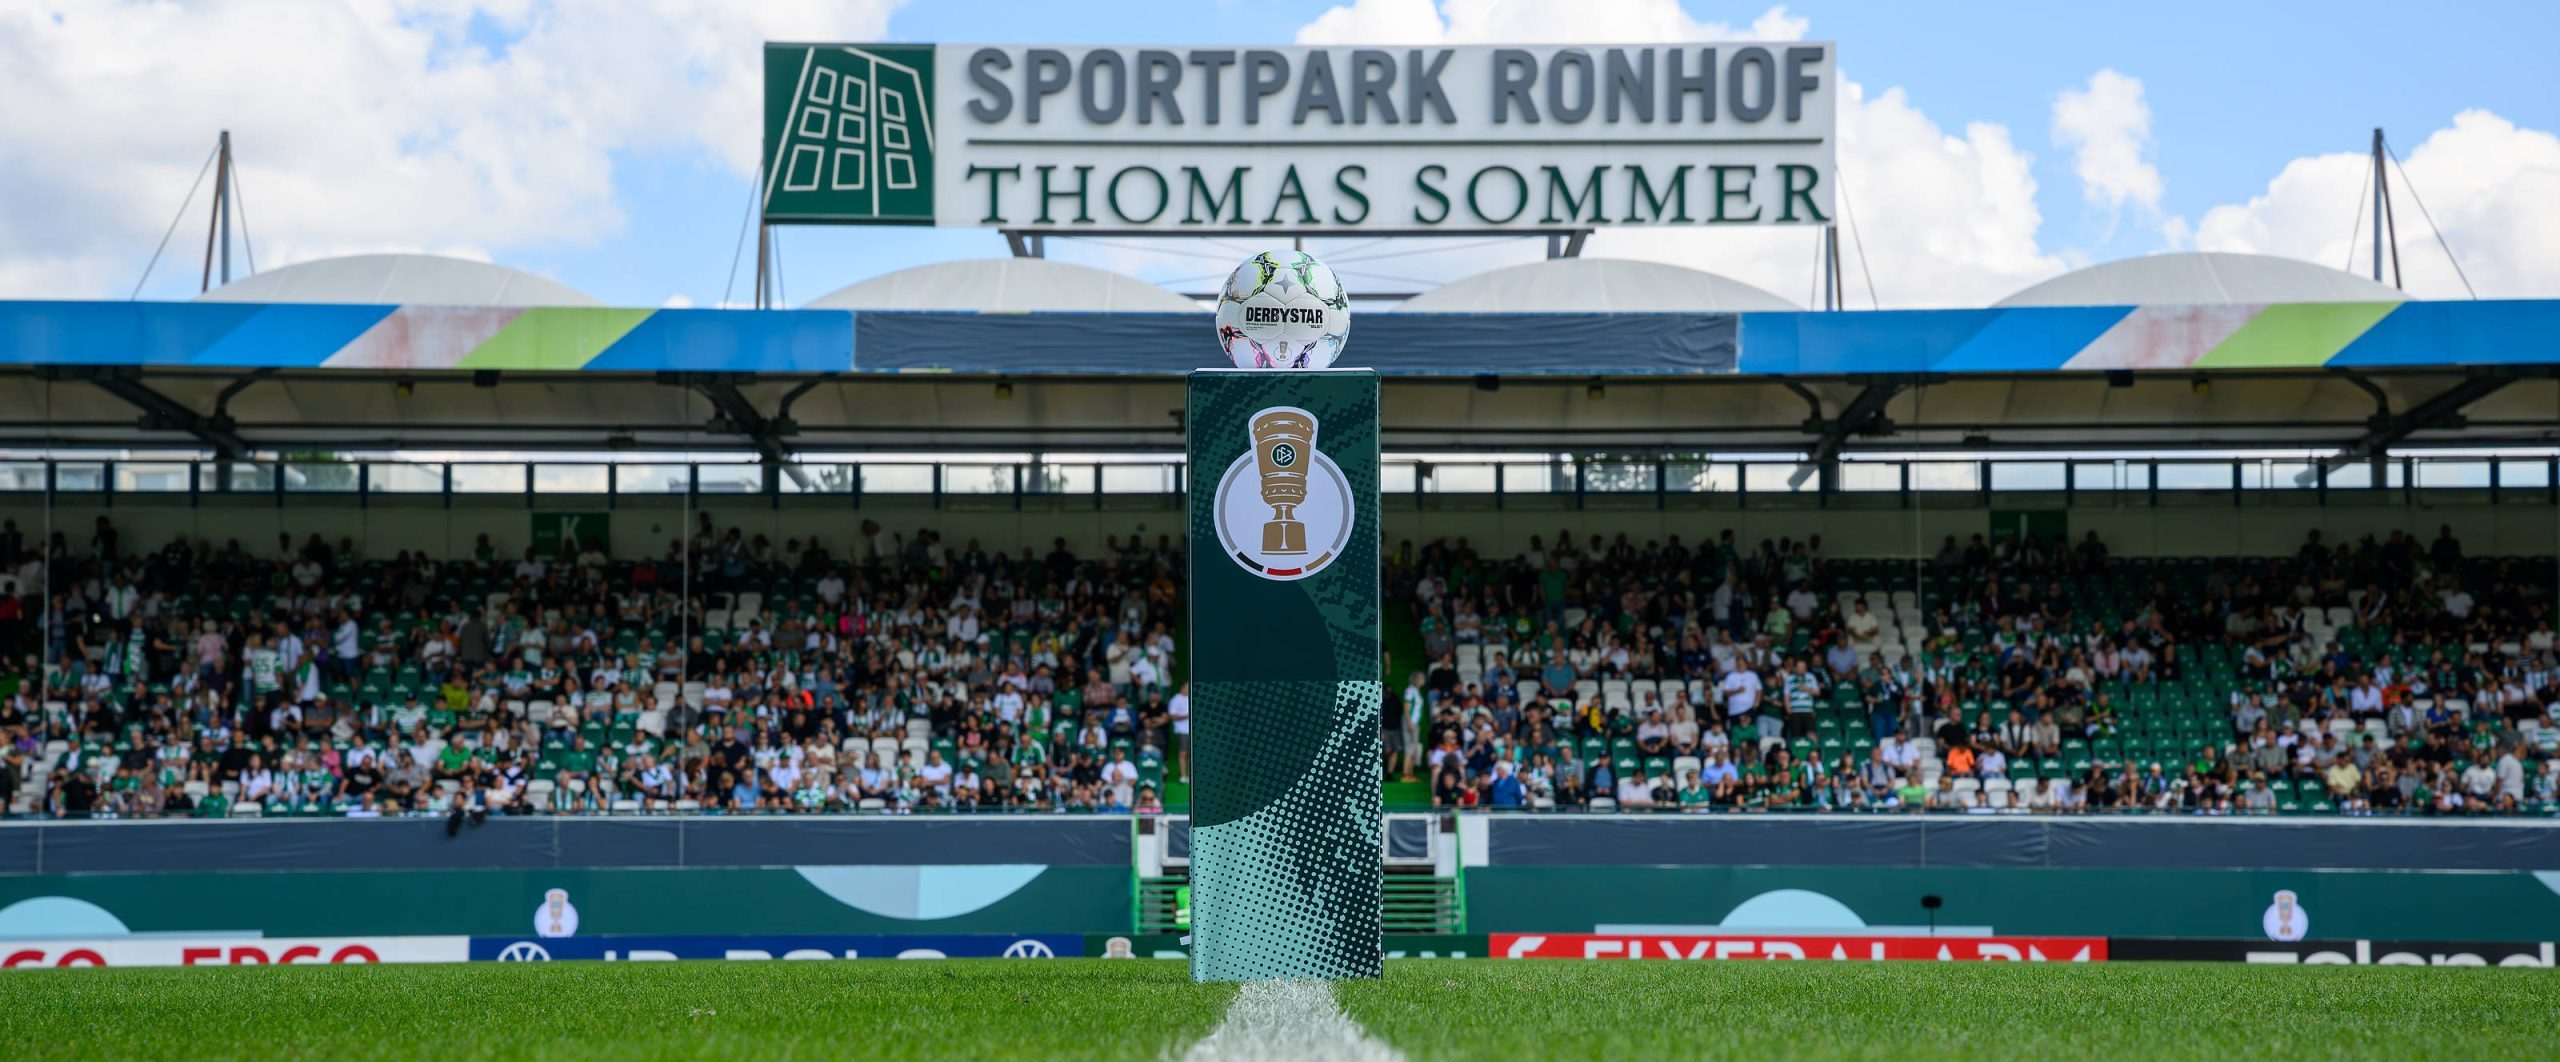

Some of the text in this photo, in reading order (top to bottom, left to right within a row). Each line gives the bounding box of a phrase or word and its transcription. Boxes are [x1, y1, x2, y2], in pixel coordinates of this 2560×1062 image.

[967, 47, 1824, 125] SPORTPARK RONHOF
[966, 163, 1831, 224] THOMAS SOMMER
[1246, 307, 1323, 323] DERBYSTAR
[561, 516, 580, 550] K
